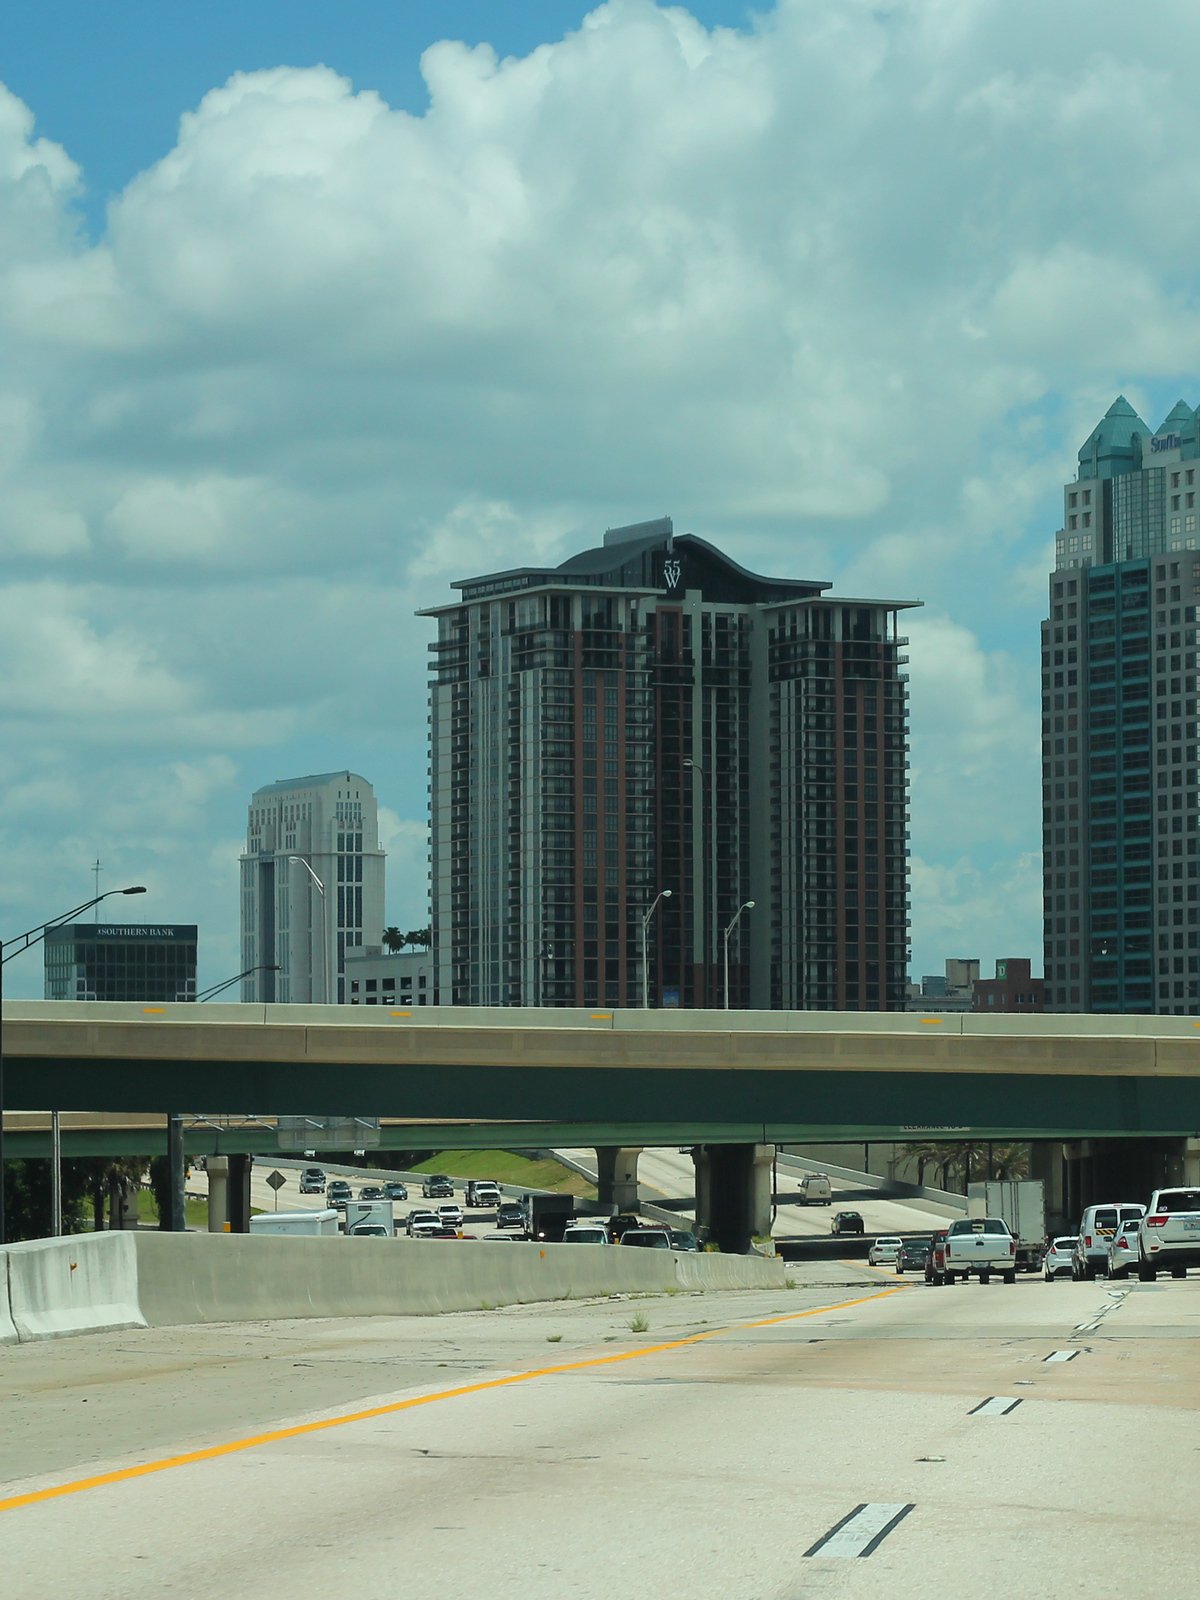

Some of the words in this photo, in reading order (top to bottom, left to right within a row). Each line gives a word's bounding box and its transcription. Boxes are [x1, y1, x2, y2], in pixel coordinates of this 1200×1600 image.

[664, 560, 680, 574] 55
[663, 573, 681, 588] W
[101, 927, 147, 936] SOUTHERN
[149, 928, 174, 936] BANK
